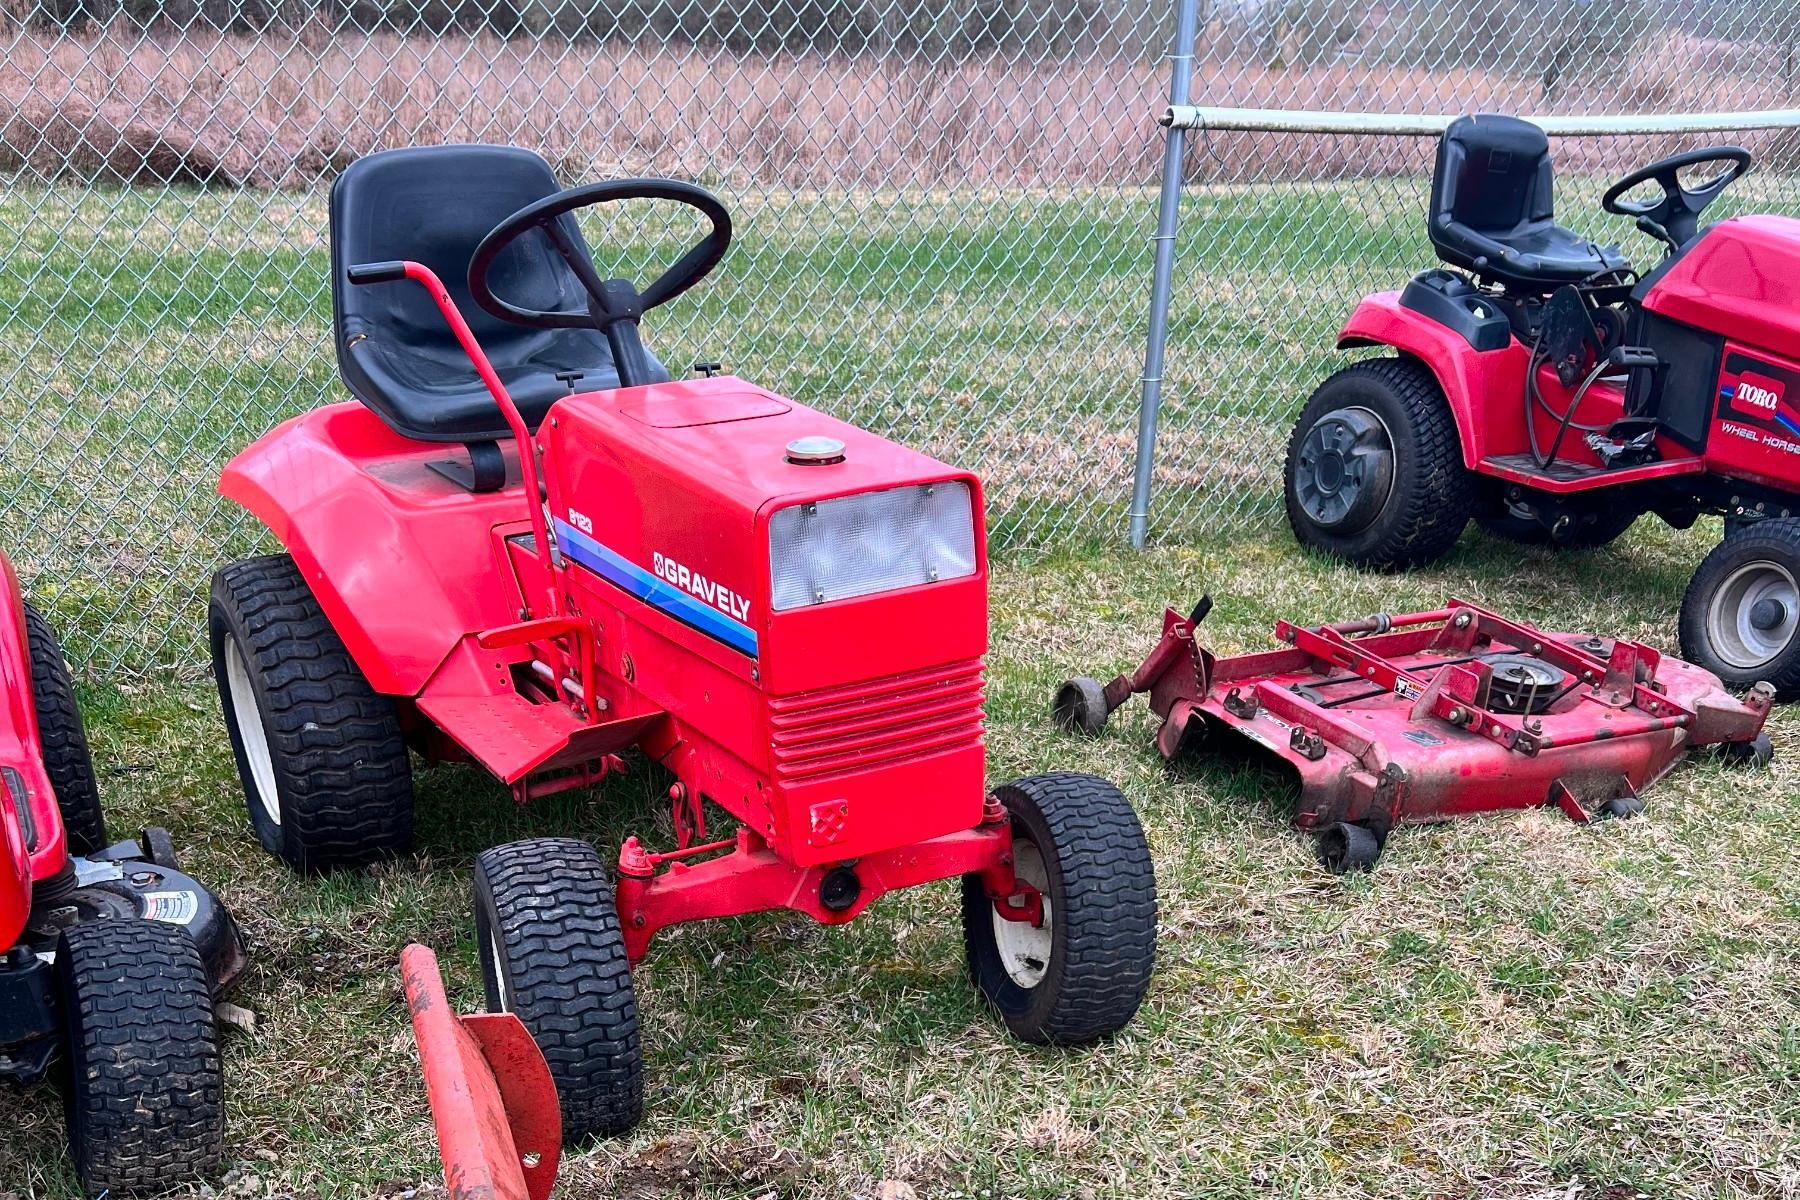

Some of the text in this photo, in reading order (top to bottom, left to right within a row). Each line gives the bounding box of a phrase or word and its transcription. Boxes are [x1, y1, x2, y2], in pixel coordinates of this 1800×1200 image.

[1737, 382, 1778, 410] TORO
[1721, 421, 1800, 455] WHEEL HORSE
[568, 507, 593, 535] 8123
[664, 557, 751, 623] GRAVELY
